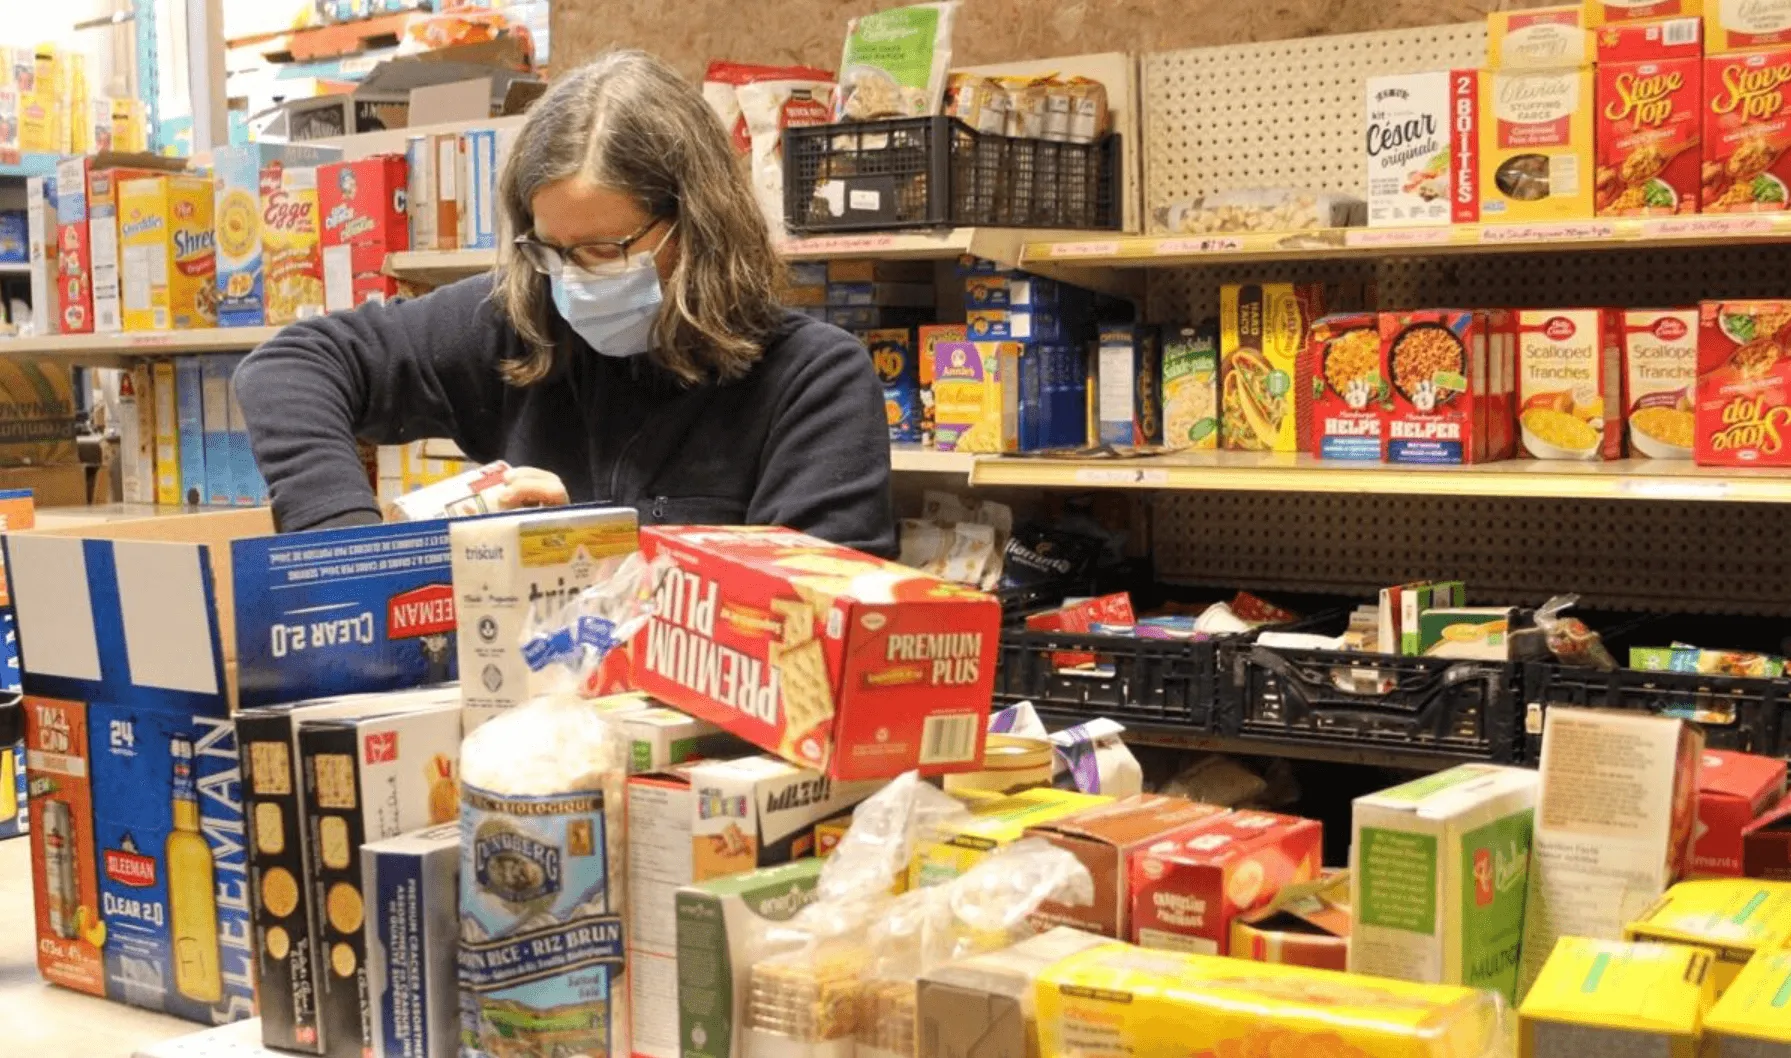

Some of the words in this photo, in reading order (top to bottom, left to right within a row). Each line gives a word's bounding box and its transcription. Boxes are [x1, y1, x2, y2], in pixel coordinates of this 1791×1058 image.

[1457, 76, 1471, 94] 2
[1604, 71, 1684, 120] Stove
[1371, 111, 1385, 120] kit
[1510, 100, 1561, 112] STUFFING
[1517, 111, 1551, 120] FARCE
[1632, 98, 1672, 132] Top
[1741, 90, 1783, 125] Top
[1367, 113, 1436, 156] César
[1381, 137, 1439, 167] originale
[263, 191, 311, 228] Eggo
[1241, 303, 1249, 335] TACO
[1252, 302, 1260, 335] HARD
[1526, 344, 1592, 360] Scalloped
[1633, 344, 1697, 361] Scallope
[1528, 365, 1590, 379] Tranches
[1638, 364, 1697, 379] Tranche
[1722, 395, 1768, 426] Top
[1324, 418, 1380, 435] HELPE
[1390, 420, 1461, 439] HELPER
[1711, 406, 1791, 455] Stove
[465, 546, 504, 561] triscuit
[271, 624, 306, 657] 2.0
[312, 612, 373, 647] CLEAR
[886, 632, 983, 662] PREMIUM
[645, 616, 781, 727] PREMIUM
[931, 657, 980, 686] PLUS
[36, 705, 70, 731] TALL
[39, 729, 69, 752] CAN
[109, 719, 135, 748] 24
[106, 854, 156, 878] SLEEMAN
[192, 715, 251, 1025] SLEEMAN
[103, 891, 142, 917] CLEAR
[143, 902, 164, 926] 2.0
[407, 878, 417, 932] PREMIUM
[486, 947, 521, 966] RICE
[531, 935, 563, 957] RIZ
[565, 924, 620, 951] BRUN
[409, 936, 421, 990] CRACKER
